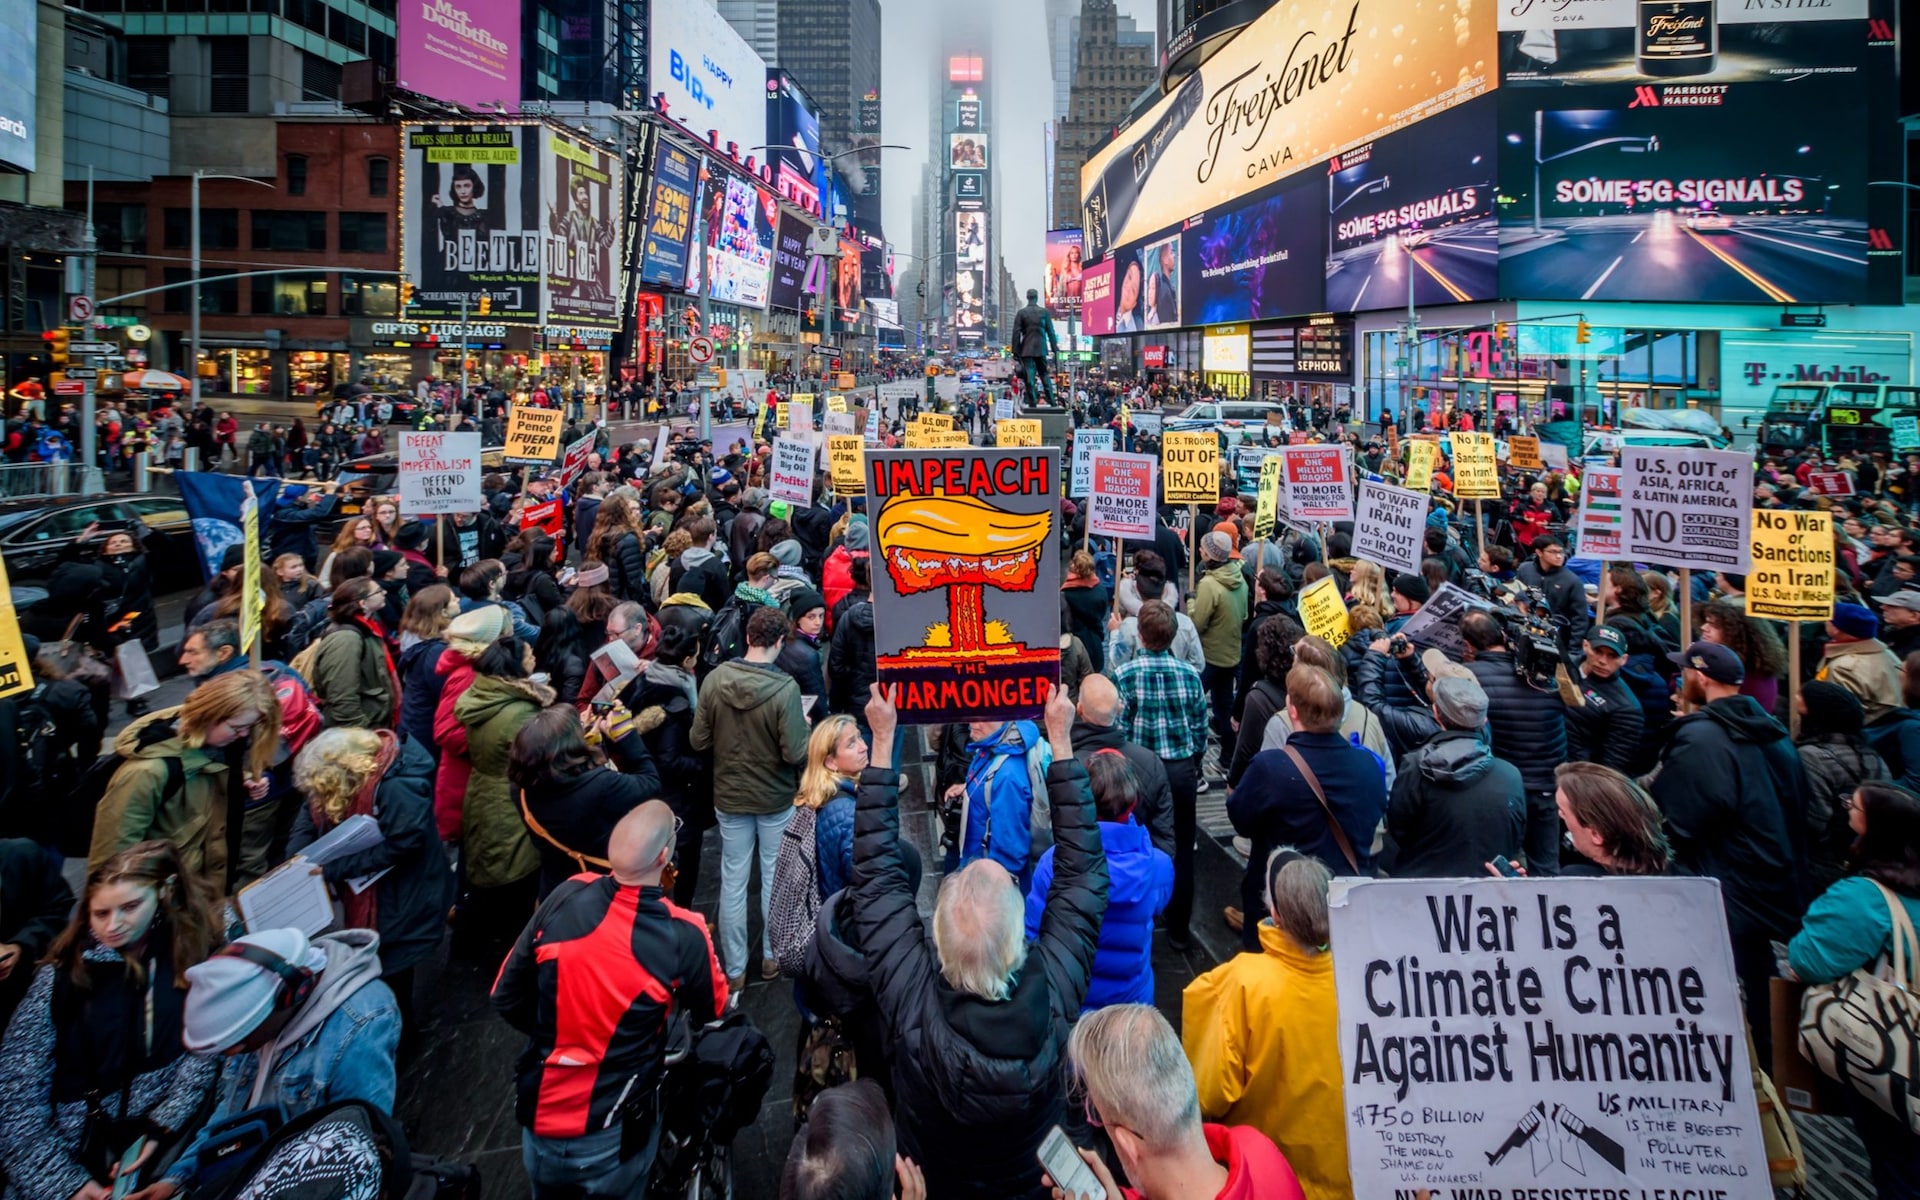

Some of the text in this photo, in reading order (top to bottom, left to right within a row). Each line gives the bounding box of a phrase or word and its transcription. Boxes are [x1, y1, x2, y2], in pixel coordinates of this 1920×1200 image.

[422, 3, 508, 55] Doubtfire
[1647, 15, 1705, 36] Freixenet
[1168, 23, 1198, 49] MARRIOTT
[1168, 36, 1194, 58] MARQUIS
[703, 54, 733, 89] HAPPY
[1197, 0, 1360, 184] Freixenet
[1664, 86, 1728, 96] MARRIOTT
[1664, 95, 1721, 105] MARQUIS
[0, 116, 27, 139] arch
[412, 133, 510, 147] TIMES SQUARE CAN REALLY
[430, 149, 517, 161] MAKE YOU FEEL ALIVE!
[1246, 146, 1294, 179] CAVA
[656, 184, 690, 211] COME
[1556, 179, 1803, 203] SOME 5G SIGNALS
[1338, 187, 1477, 241] SOME 5G SIGNALS
[651, 218, 687, 242] AWAY
[444, 231, 539, 271] BEETLE
[783, 235, 802, 253] HAPPY
[776, 249, 806, 271] NEW YEAR
[1201, 269, 1209, 279] We
[1209, 266, 1225, 279] Belong
[1231, 258, 1260, 274] Something
[1260, 250, 1289, 265] Beautiful
[372, 322, 506, 337] GIFTS LUGGAGE
[1310, 318, 1334, 326] SEPHORA
[544, 327, 613, 340] GIFTS LUGGAGE
[1469, 332, 1501, 378] T
[1297, 360, 1342, 372] SEPHORA
[516, 410, 558, 423] Trump/
[517, 421, 553, 433] Pence
[406, 434, 445, 447] DEFEAT
[509, 432, 556, 445] ¡FUERA
[830, 440, 858, 450] U.S. OUT
[1184, 437, 1216, 446] TROOPS
[521, 445, 542, 456] YA!
[778, 442, 810, 454] No More
[779, 451, 807, 463] War for
[1167, 449, 1216, 463] OUT OF
[401, 458, 472, 472] IMPERIALISM
[780, 461, 806, 472] Big Oil
[1111, 461, 1130, 469] KILLED
[1113, 468, 1132, 477] ONE
[1635, 457, 1738, 480] U.S. OUT of
[422, 474, 465, 487] DEFEND
[774, 472, 809, 487] Profits!
[872, 457, 1049, 497] IMPEACH
[1104, 476, 1141, 486] MILLION
[1168, 471, 1215, 492] IRAQ!
[1588, 477, 1613, 489] U.S.
[424, 487, 452, 498] IRAN
[1104, 484, 1140, 495] IRAQIS!
[1639, 475, 1731, 495] ASIA, AFRICA,
[1096, 495, 1149, 509] NO MORE
[1366, 488, 1420, 510] NO WAR
[1632, 490, 1738, 509] & LATIN AMERICA
[1094, 505, 1149, 517] MURDERING FOR
[1379, 501, 1404, 513] WITH
[1103, 513, 1140, 523] WALL ST!
[1368, 507, 1412, 529] IRAN!
[1631, 508, 1677, 543] NO
[1684, 514, 1736, 527] COUPS
[1757, 511, 1825, 532] No War
[1360, 522, 1416, 547] U.S. OUT
[1683, 525, 1738, 539] COLONIES
[1788, 534, 1804, 544] or
[1360, 538, 1373, 546] OF
[1375, 540, 1411, 560] IRAQ!
[1682, 536, 1738, 549] SANCTIONS
[1632, 546, 1736, 564] INTERNATIONAL ACTION CENTER
[1752, 542, 1831, 564] Sanctions
[1757, 568, 1829, 587] on Iran!
[1752, 586, 1771, 598] U.S.
[1774, 588, 1791, 601] Out
[1793, 590, 1801, 601] of
[952, 661, 987, 675] THE
[880, 677, 1051, 710] WARMONGER
[1426, 894, 1625, 954] War Is a
[1364, 953, 1706, 1018] Climate Crime
[1352, 1019, 1514, 1102] Against
[1525, 1018, 1734, 1102] Humanity
[1628, 1096, 1726, 1116] MILITARY
[1352, 1103, 1485, 1128] $750 BILLION
[1627, 1118, 1743, 1137] IS THE BIGGEST
[1377, 1129, 1446, 1147] TO DESTROY
[1384, 1144, 1454, 1159] THE WORLD
[1648, 1139, 1726, 1159] POLLUTER
[1379, 1158, 1445, 1171] SHAME ON
[1640, 1157, 1748, 1178] IN THE WORLD
[1400, 1170, 1484, 1184] U.S. CONGRESS!
[1450, 1188, 1502, 1200] WAR
[1511, 1188, 1631, 1200] RESISTERS
[1640, 1188, 1728, 1200] LEAGUE
